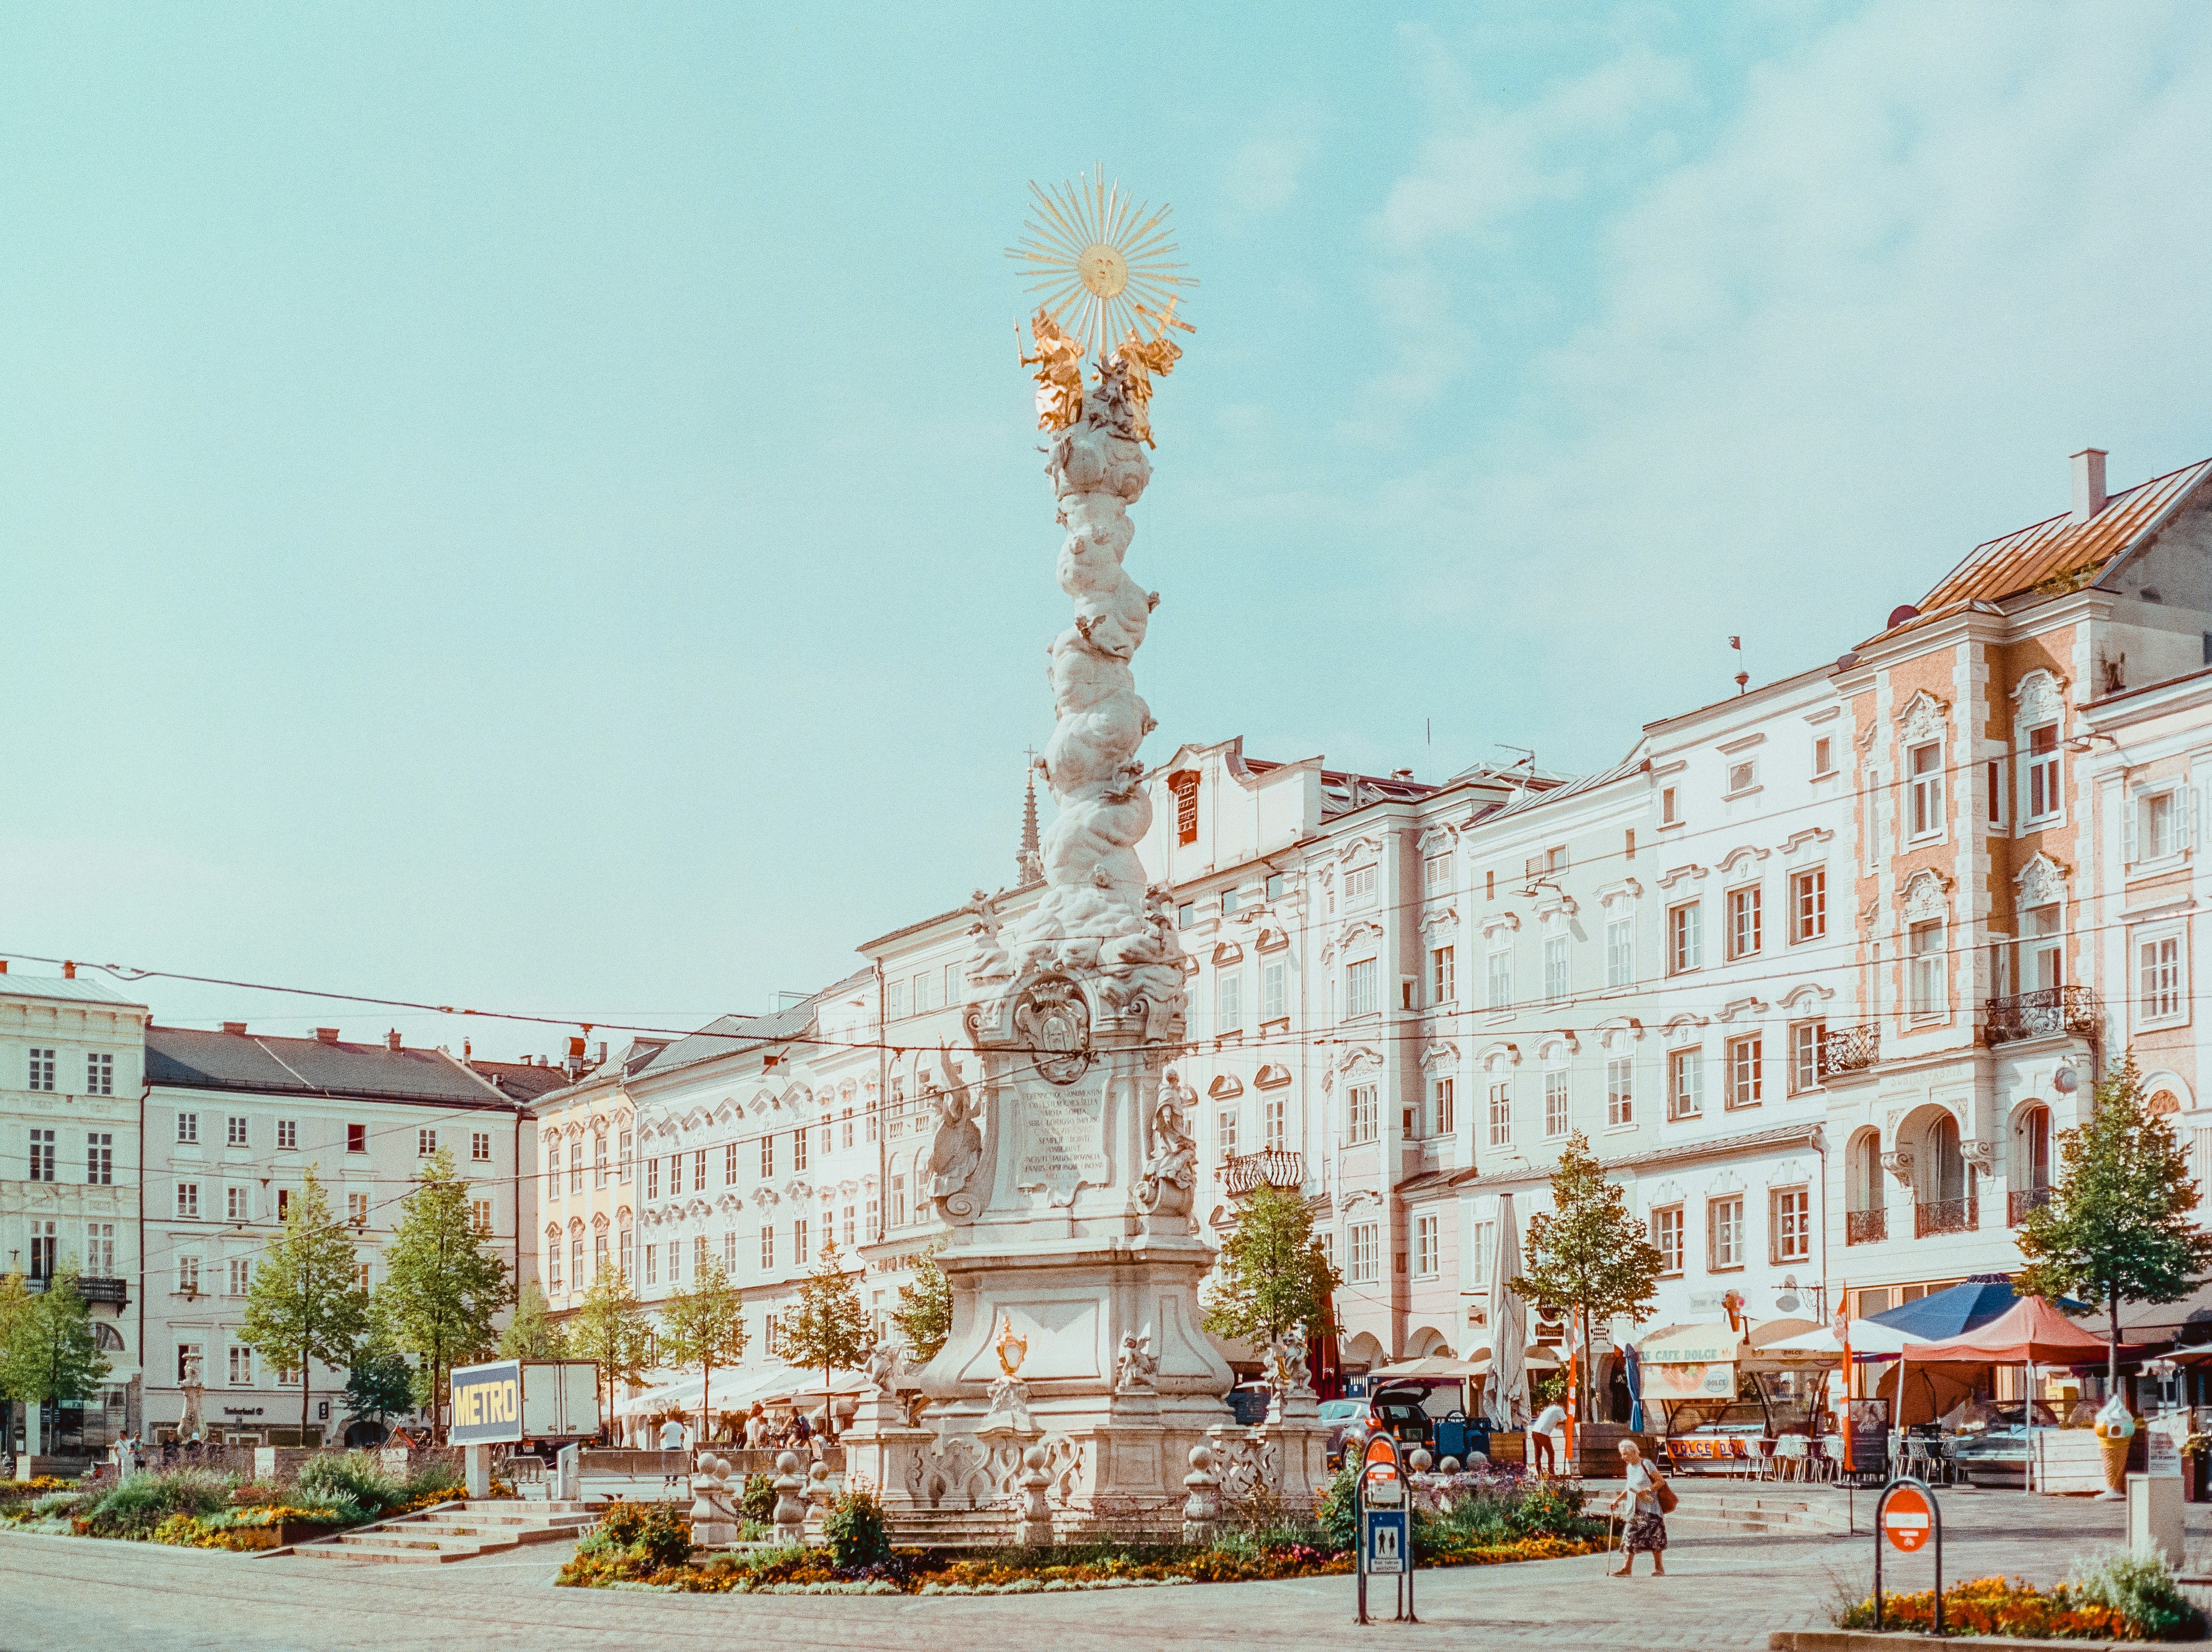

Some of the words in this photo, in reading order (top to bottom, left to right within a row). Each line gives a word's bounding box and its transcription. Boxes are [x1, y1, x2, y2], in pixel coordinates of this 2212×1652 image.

[1655, 1350, 1680, 1361] CAFE
[1684, 1349, 1717, 1360] DOLCE
[454, 1379, 517, 1427] METRO
[1672, 1443, 1711, 1453] DOLCE
